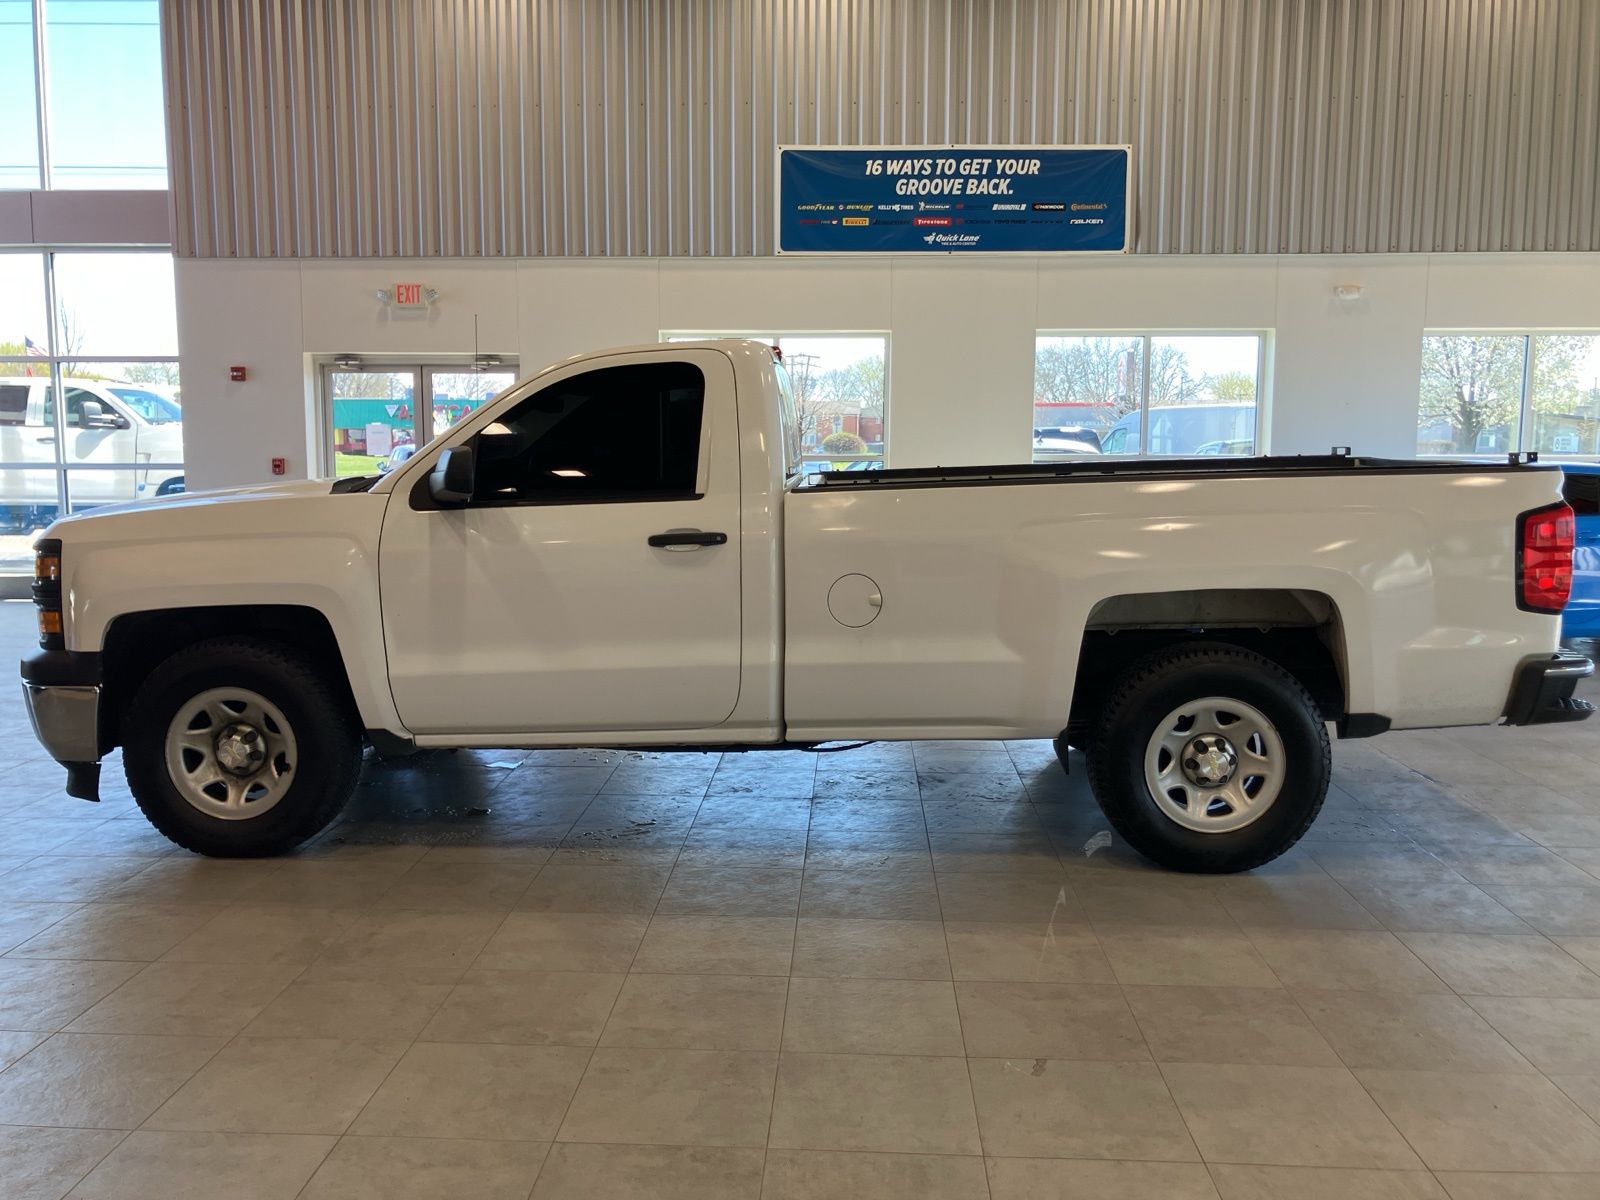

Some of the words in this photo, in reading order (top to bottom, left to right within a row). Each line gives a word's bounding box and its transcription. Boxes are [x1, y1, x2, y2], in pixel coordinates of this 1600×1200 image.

[865, 159, 883, 175] 16
[886, 159, 933, 175] WAYS
[935, 159, 957, 175] TO
[959, 159, 992, 175] GET
[996, 159, 1041, 175] YOUR
[895, 179, 964, 195] GROOVE
[965, 179, 1014, 195] BACK.
[797, 203, 835, 211] GOODYEAR
[935, 233, 959, 242] Quick
[959, 233, 980, 242] Lane
[397, 284, 421, 304] EXIT
